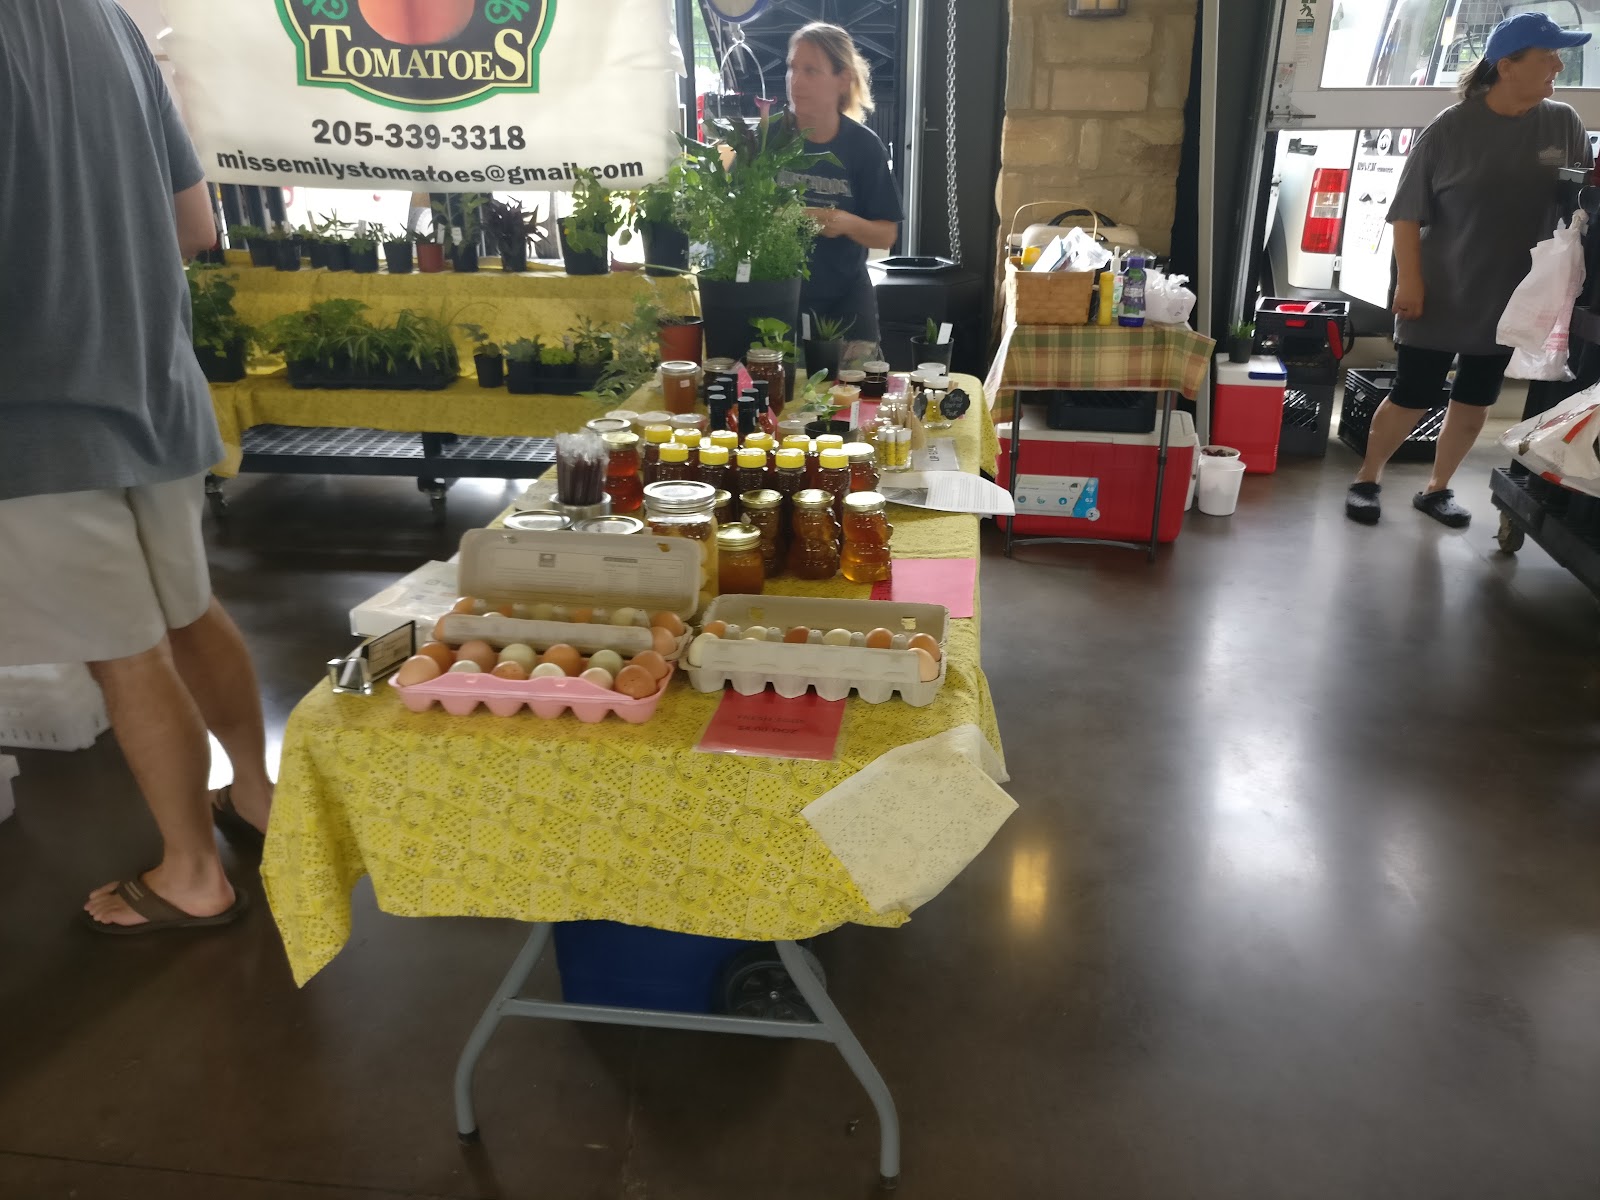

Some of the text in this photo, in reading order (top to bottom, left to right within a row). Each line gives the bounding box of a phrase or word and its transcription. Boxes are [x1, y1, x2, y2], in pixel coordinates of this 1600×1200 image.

[310, 24, 526, 81] TOMATOES
[311, 118, 527, 151] 205-339-3318
[216, 149, 644, 186] missemilystomatoes@gmailcom
